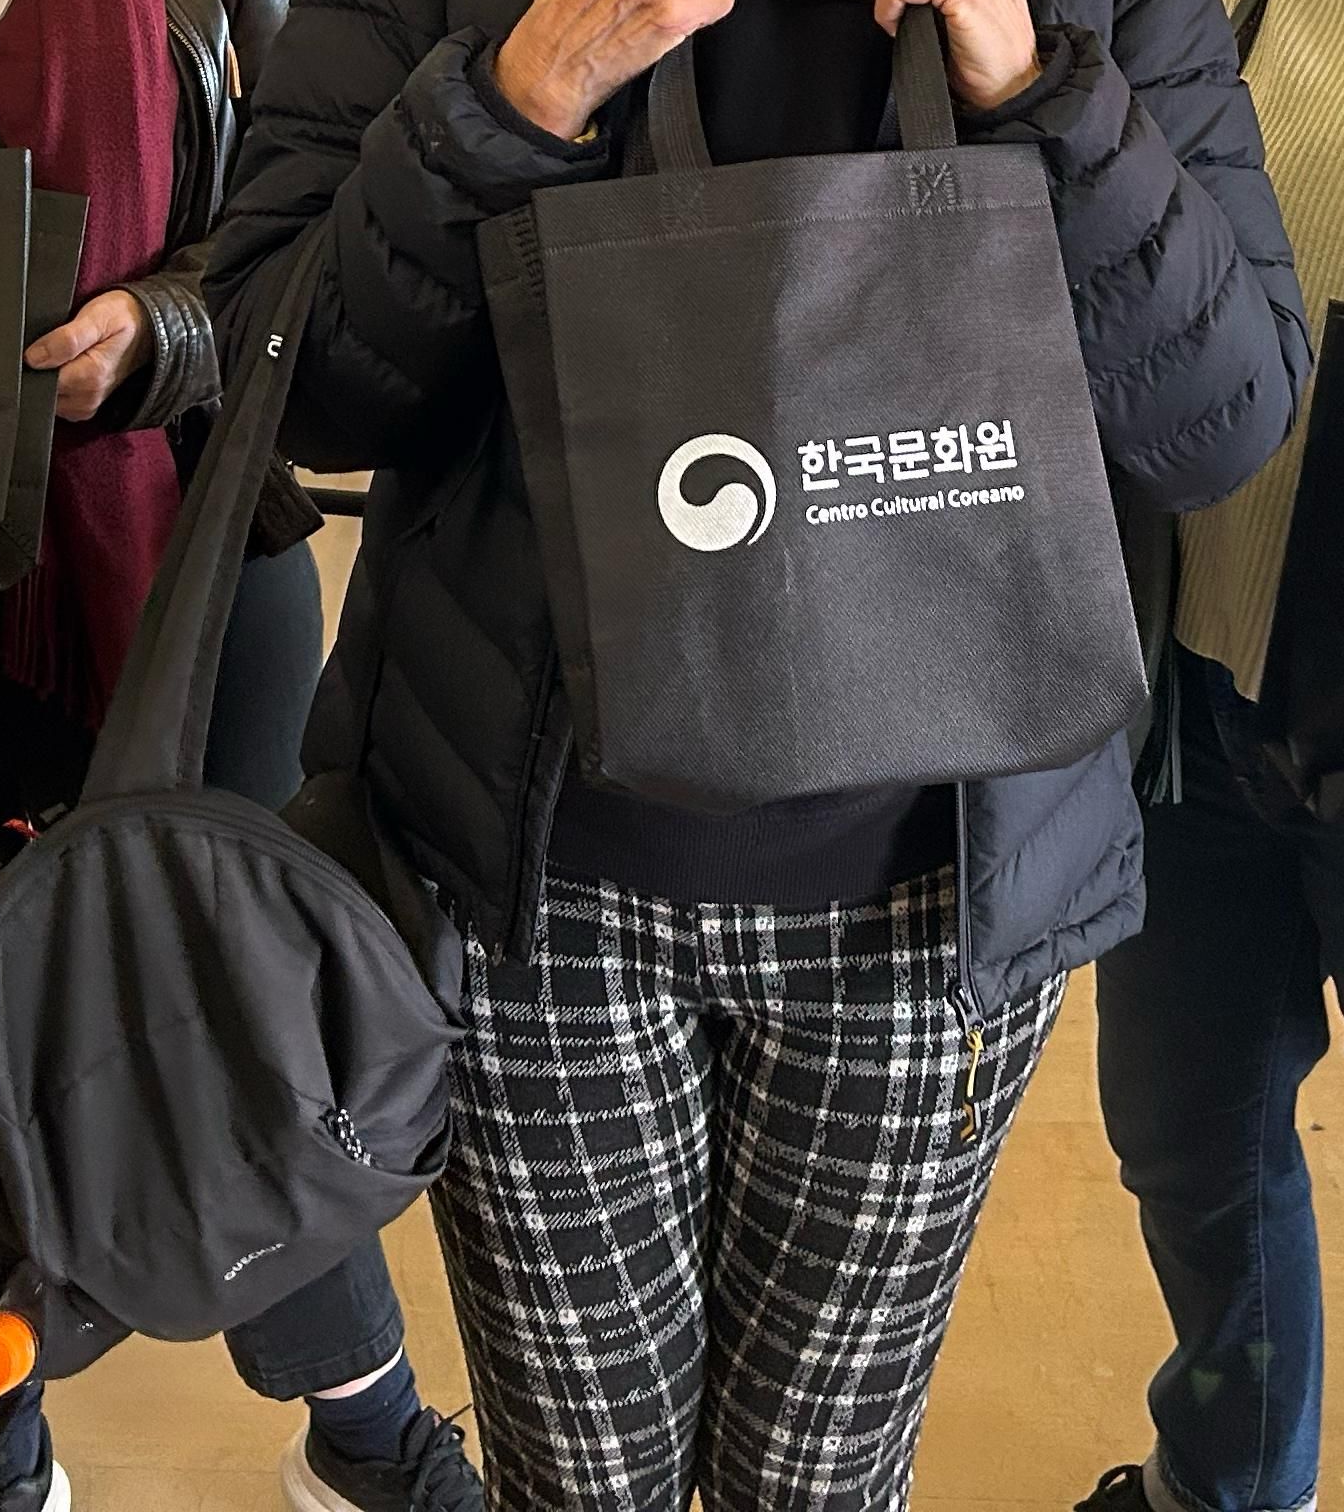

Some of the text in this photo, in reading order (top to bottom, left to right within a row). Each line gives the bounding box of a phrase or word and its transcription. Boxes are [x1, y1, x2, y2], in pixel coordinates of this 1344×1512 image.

[797, 419, 1019, 492] 한국문화원
[805, 484, 1025, 525] Centro Cultural Coreano
